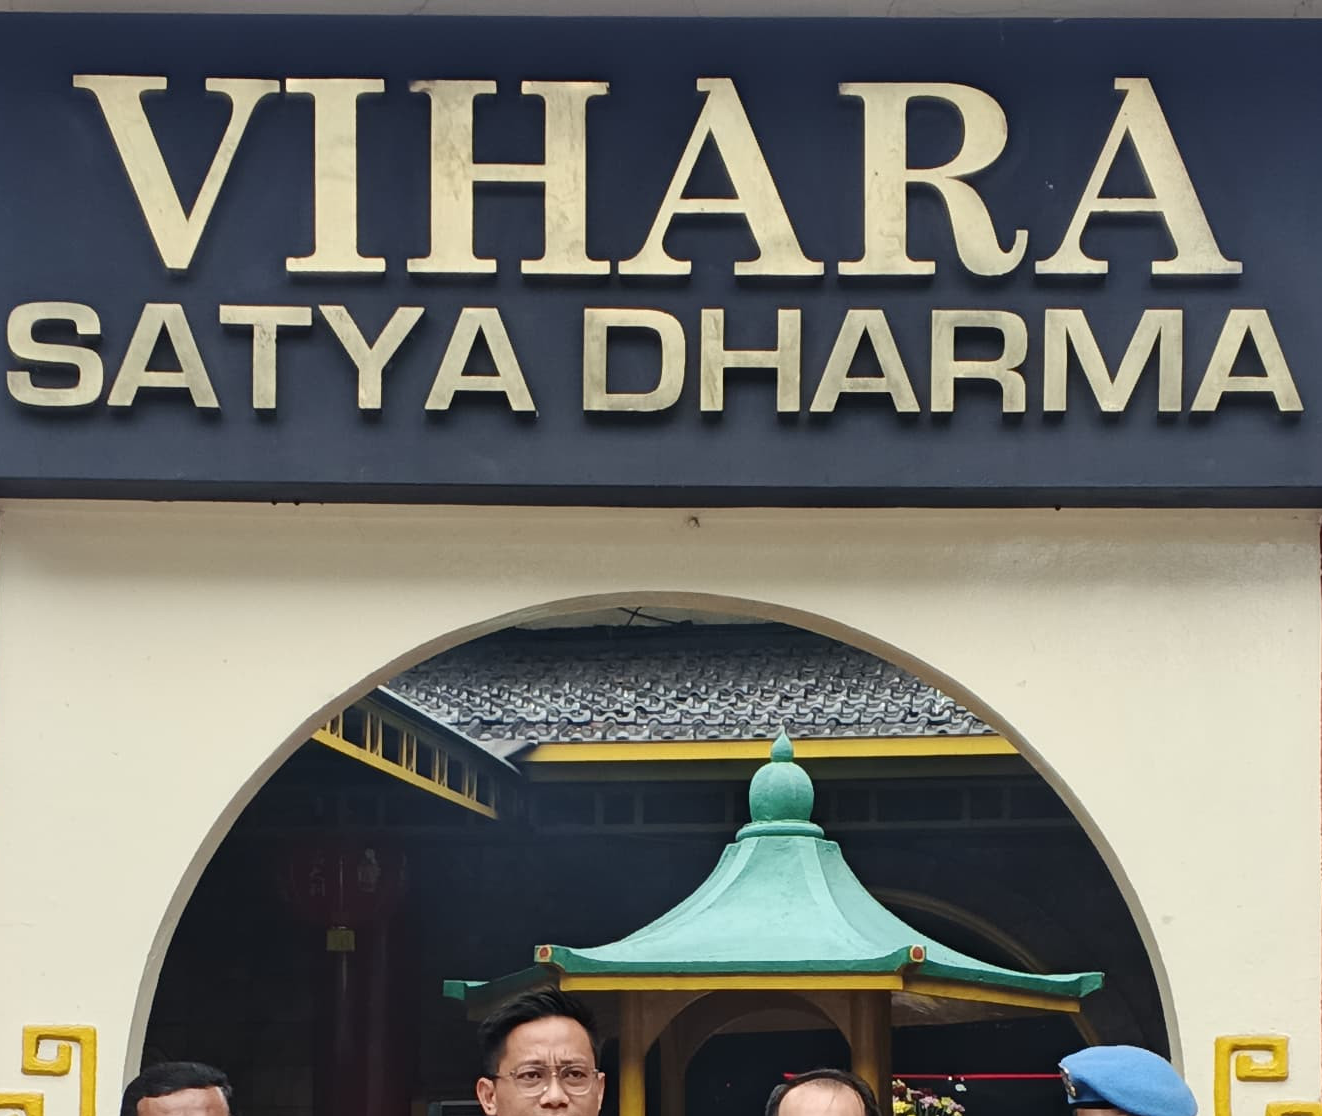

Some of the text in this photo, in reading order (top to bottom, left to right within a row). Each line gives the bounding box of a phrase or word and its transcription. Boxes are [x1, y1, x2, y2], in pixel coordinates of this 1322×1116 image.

[73, 75, 1243, 279] VIHARA
[5, 301, 1304, 414] SATYA DHARMA
